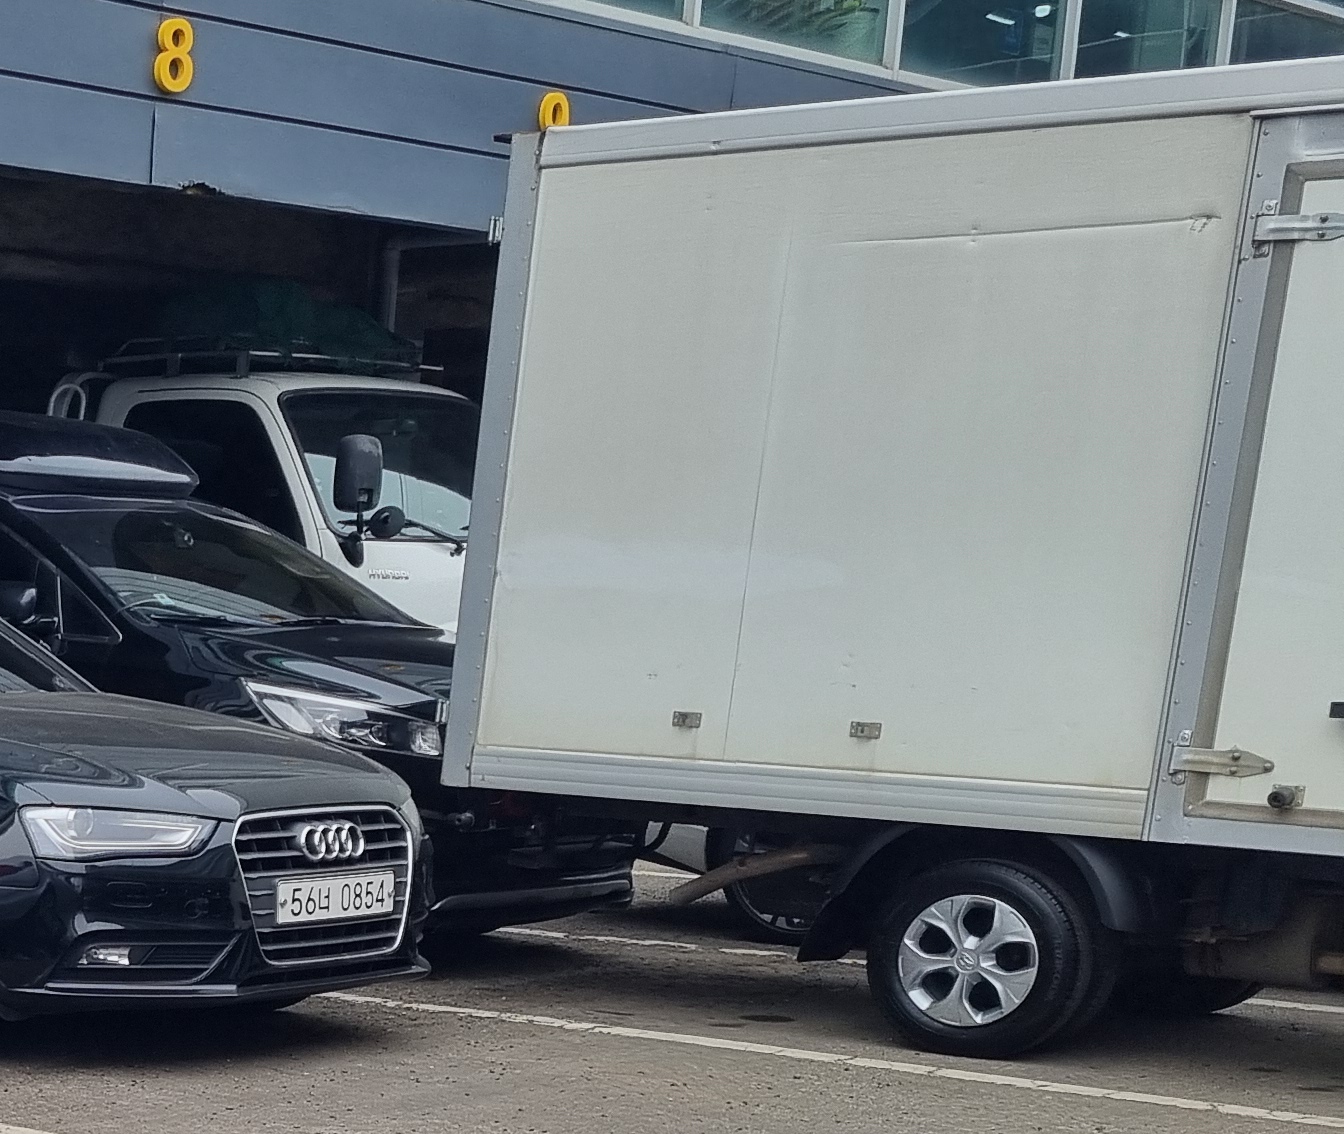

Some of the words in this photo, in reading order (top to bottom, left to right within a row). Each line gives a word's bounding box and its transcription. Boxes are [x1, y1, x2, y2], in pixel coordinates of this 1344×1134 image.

[154, 18, 193, 93] 8
[291, 886, 331, 916] 56너
[341, 880, 386, 912] 0854
